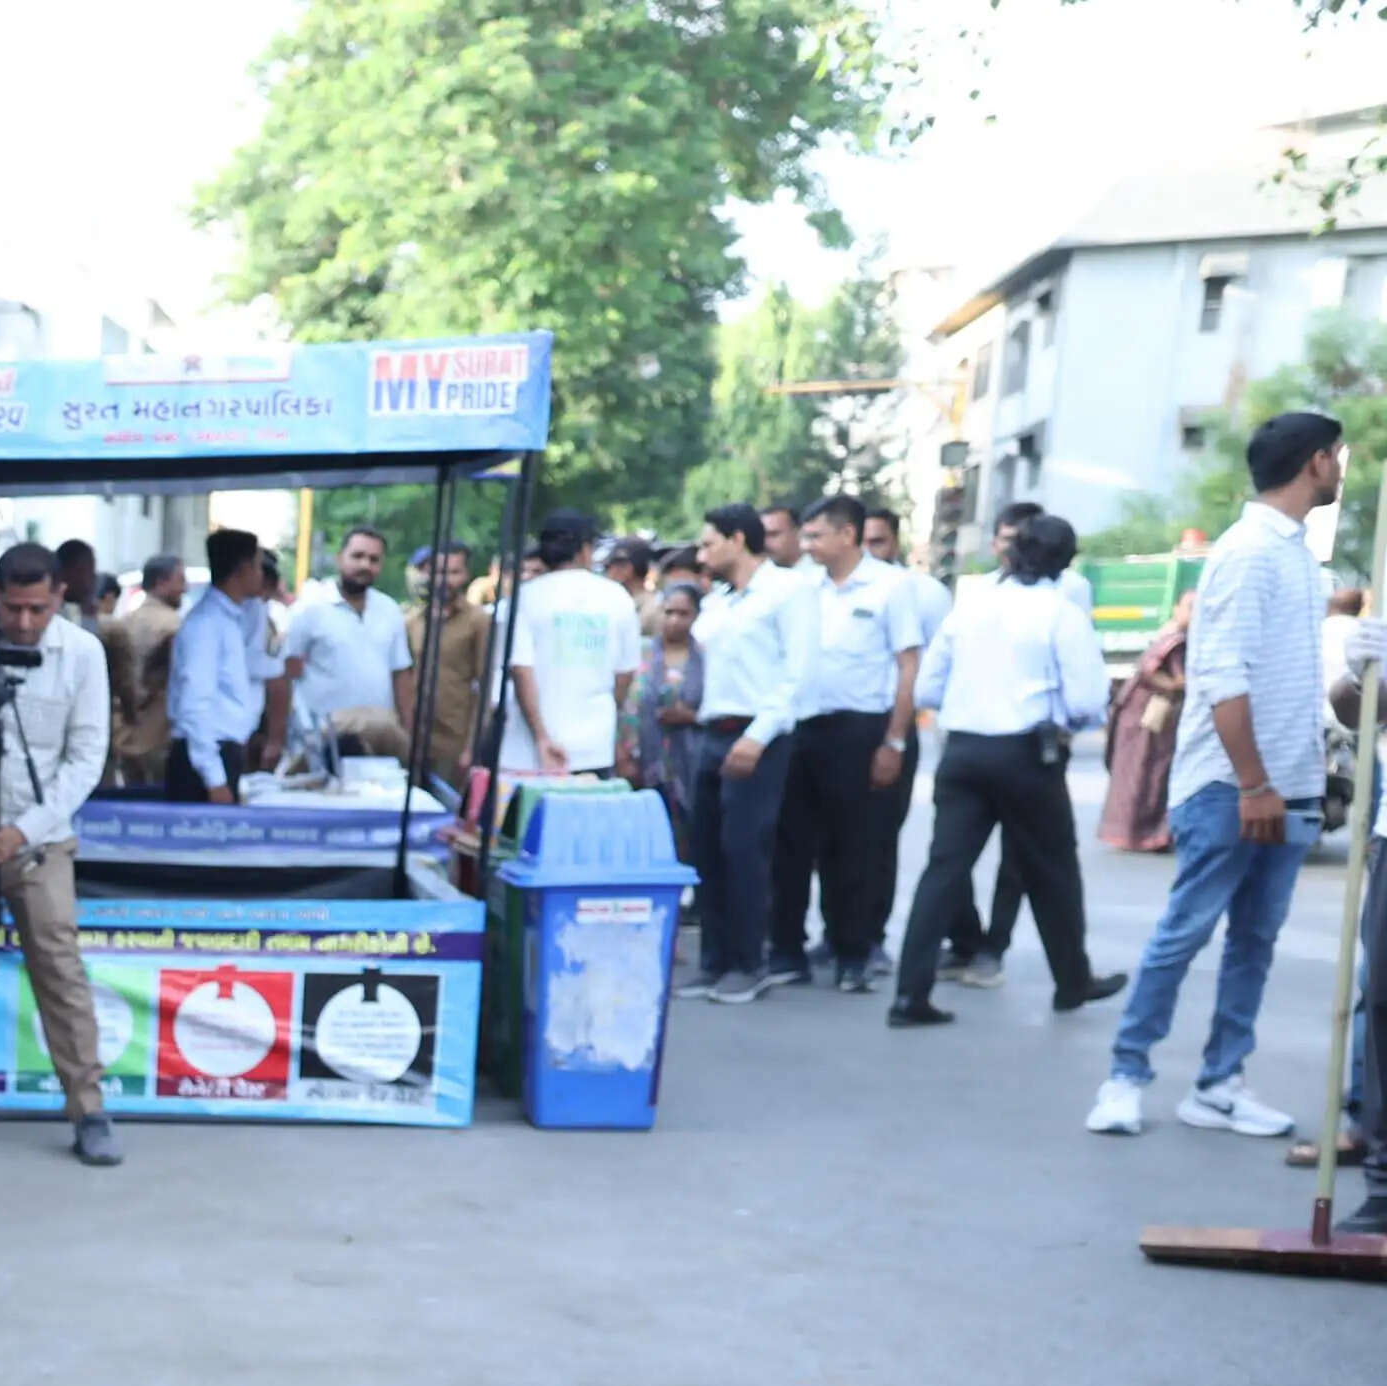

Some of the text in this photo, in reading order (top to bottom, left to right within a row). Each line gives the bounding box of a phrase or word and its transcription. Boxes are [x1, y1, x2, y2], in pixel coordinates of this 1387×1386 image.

[453, 348, 526, 379] SURAT
[374, 354, 448, 411] MY
[446, 381, 512, 409] PRIDE
[62, 389, 333, 430] સુરત મહાનગરપાલિકા
